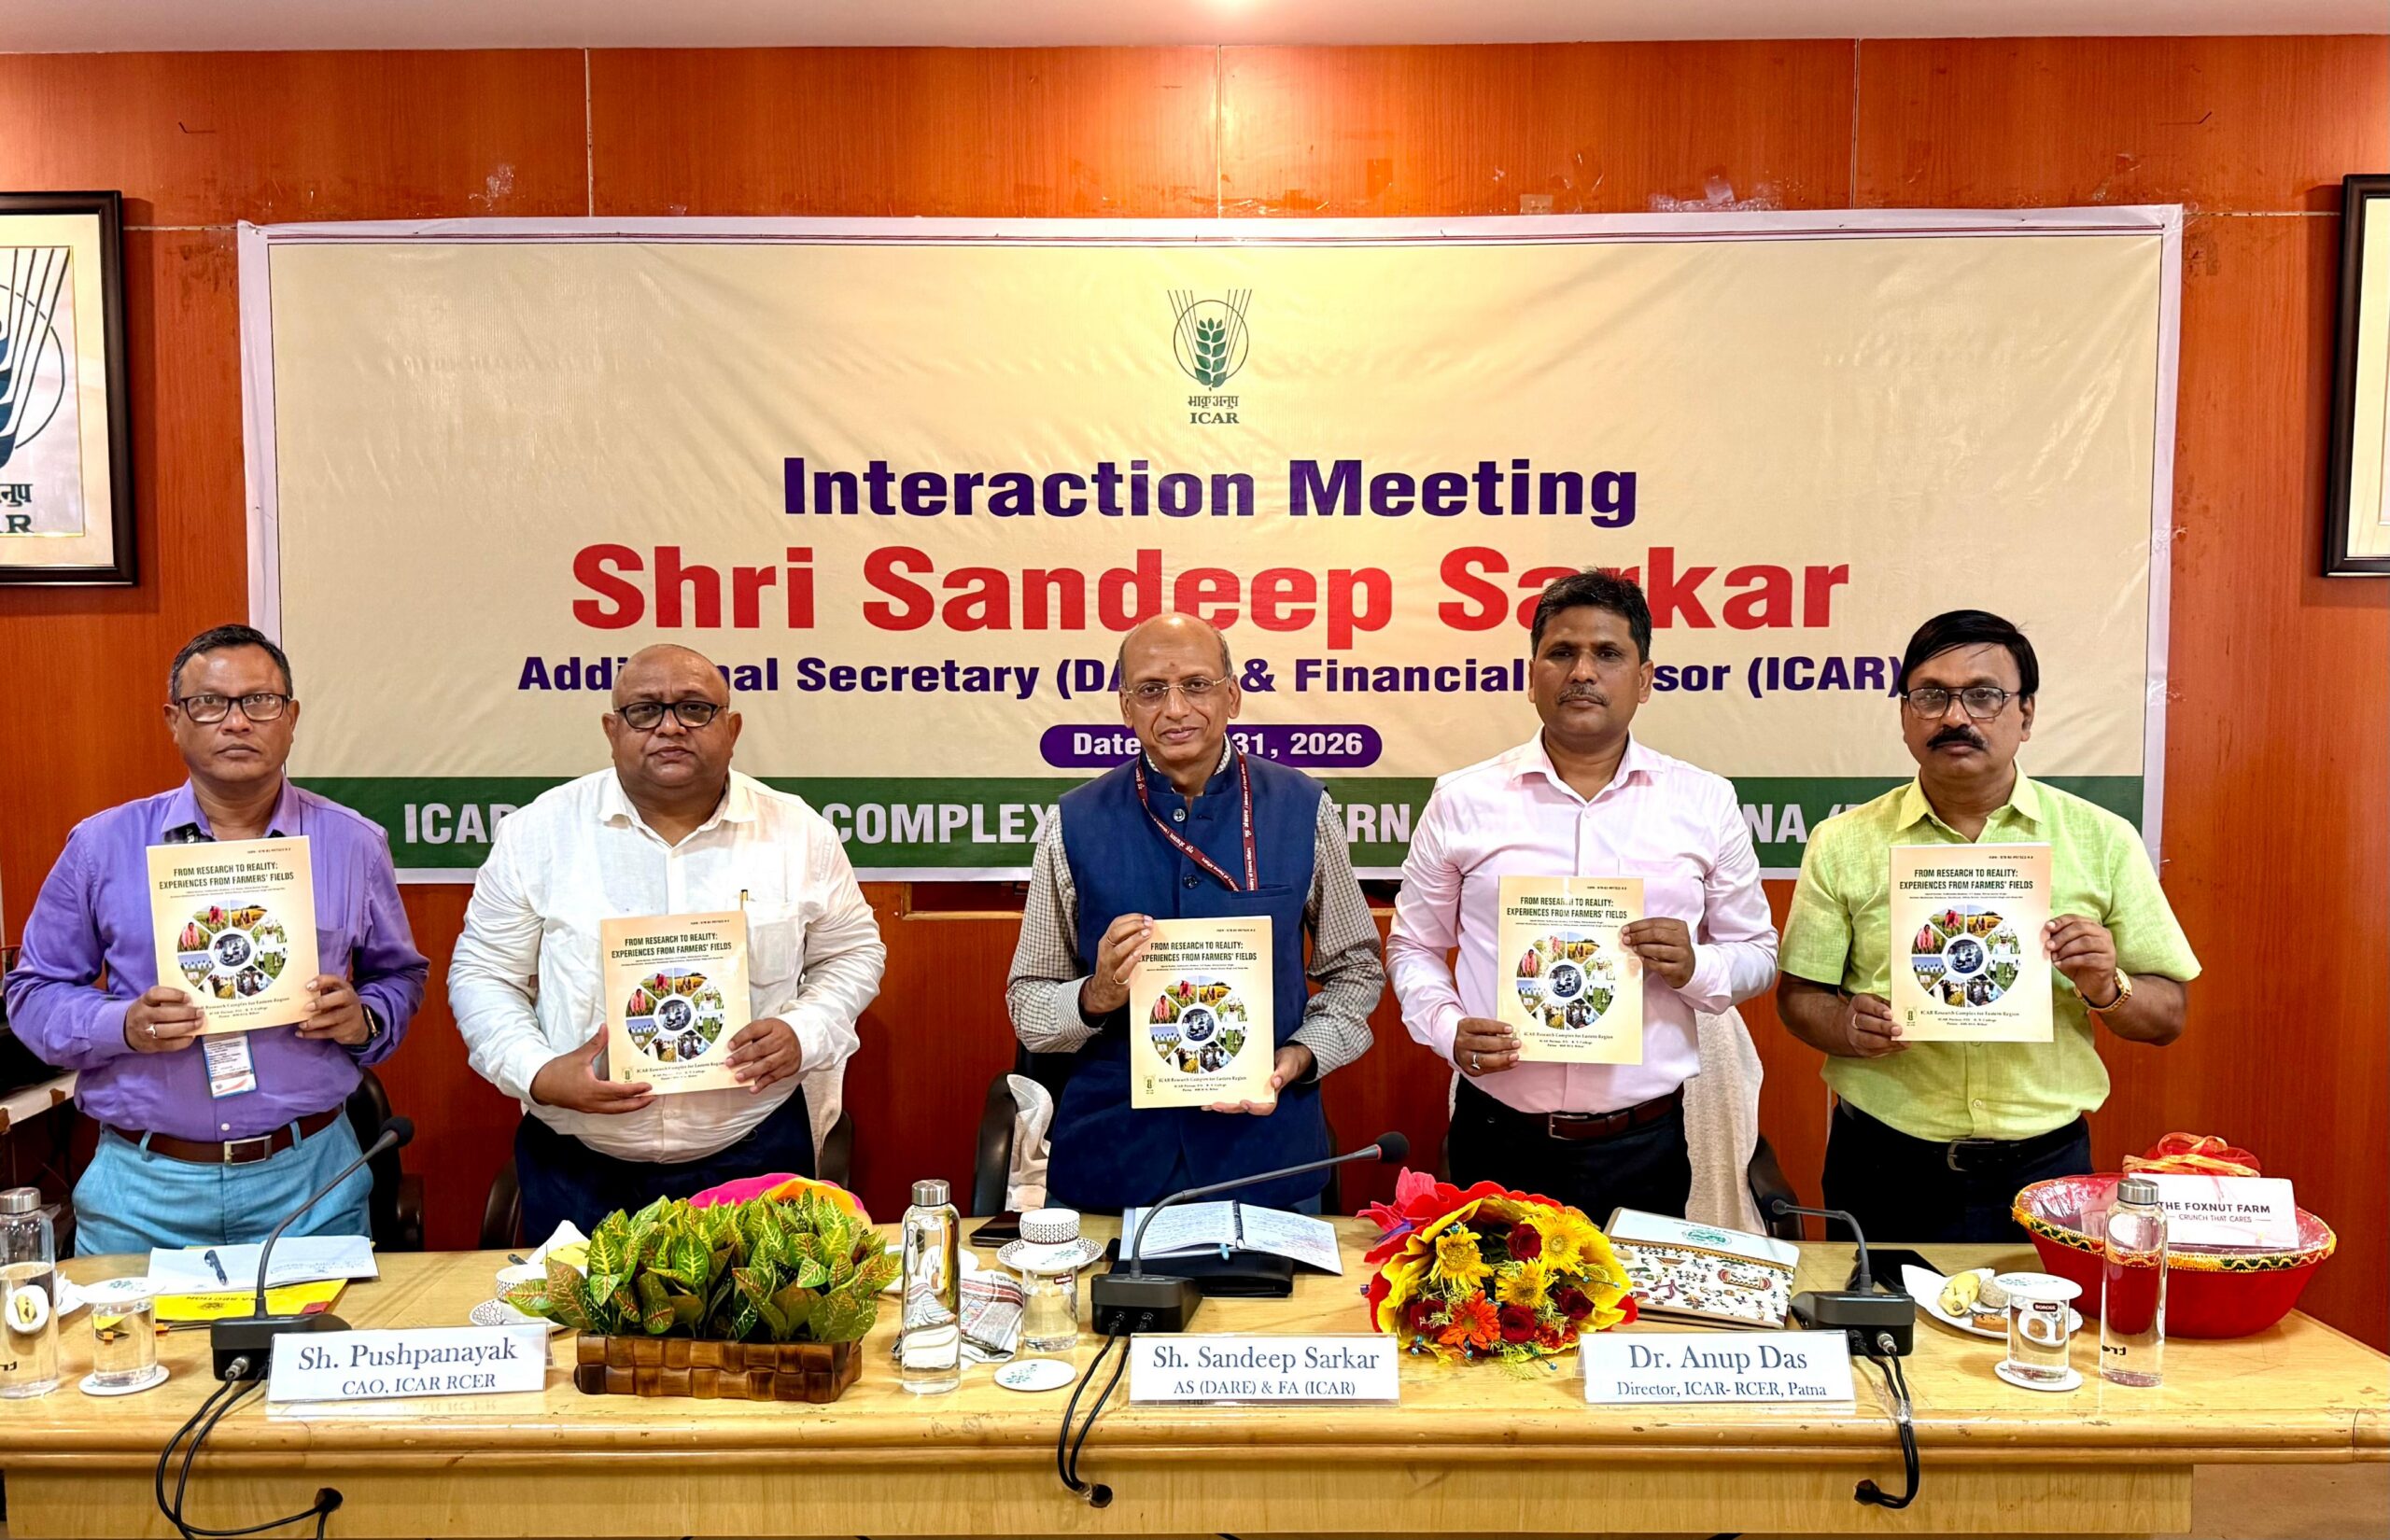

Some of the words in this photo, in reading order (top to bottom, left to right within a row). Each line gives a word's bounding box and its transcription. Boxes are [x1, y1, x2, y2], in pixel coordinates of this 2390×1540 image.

[1189, 412, 1240, 425] ICAR
[784, 456, 1255, 518] Interaction
[1289, 459, 1638, 528] Meeting
[571, 543, 815, 631] Shri
[863, 544, 1393, 651] Sandeep
[797, 657, 1040, 701] Secretary
[1239, 658, 1276, 693] &
[1295, 658, 1525, 693] Financial
[1748, 656, 1903, 699] (ICAR)
[1289, 731, 1364, 757] 2026
[822, 803, 1060, 844] COMPLEX
[174, 866, 195, 877] FROM
[196, 864, 233, 875] RESEARCH
[235, 863, 245, 873] TO
[246, 861, 278, 872] REALITY:
[1914, 869, 1934, 877] FROM
[1936, 869, 1974, 877] RESEARCH
[1975, 869, 1985, 877] TO
[1986, 869, 2018, 877] REALITY:
[159, 878, 207, 889] EXPERIENCES
[209, 876, 231, 886] FROM
[270, 872, 294, 881] FIELDS
[1900, 881, 1947, 889] EXPERIENCES
[1948, 881, 1969, 889] FROM
[2009, 880, 2033, 889] FIELDS
[1521, 896, 1539, 905] FROM
[1540, 897, 1574, 906] RESEARH
[1576, 898, 1583, 906] TO
[1585, 899, 1613, 907] REALITY:
[1507, 907, 1550, 917] EXPERIENCES
[1551, 909, 1569, 917] FROM
[1606, 910, 1627, 919] FIELDS
[625, 937, 644, 946] FROM
[645, 935, 679, 945] RESEARCH
[681, 934, 688, 943] TO
[690, 932, 718, 942] REALITY:
[1150, 942, 1169, 950] FROM
[1171, 942, 1203, 950] RESEARCH
[1205, 941, 1214, 949] TO
[1215, 941, 1243, 949] REALITY:
[612, 947, 654, 959] EXPERIENCES
[656, 946, 675, 955] FROM
[710, 942, 732, 951] FIELDS
[1182, 953, 1200, 961] FROM
[1236, 952, 1257, 960] FIELDS
[2158, 1201, 2181, 1211] THE
[2185, 1202, 2233, 1212] FOXNUT
[2237, 1204, 2270, 1213] FARM
[2178, 1213, 2208, 1222] CRUNCH
[298, 1346, 339, 1371] Sh.
[349, 1337, 519, 1369] Pushpanayak
[1153, 1345, 1189, 1368] Sh.
[1198, 1346, 1296, 1373] Sandeep
[1304, 1346, 1380, 1369] Sarkar
[1628, 1344, 1671, 1369] Dr.
[1680, 1345, 1750, 1374] Anup
[1758, 1345, 1807, 1369] Das
[342, 1379, 389, 1395] CAO,
[395, 1377, 441, 1393] ICAR
[446, 1373, 496, 1390] RCER
[1174, 1380, 1195, 1394] AS
[1200, 1379, 1257, 1395] (DARE)
[1261, 1381, 1272, 1394] &
[1279, 1381, 1298, 1394] FA
[1305, 1380, 1356, 1396] (ICAR)
[1617, 1381, 1680, 1398] Director,
[1685, 1382, 1731, 1395] ICAR-
[1735, 1382, 1784, 1397] RCER,
[1789, 1382, 1827, 1396] Patna
